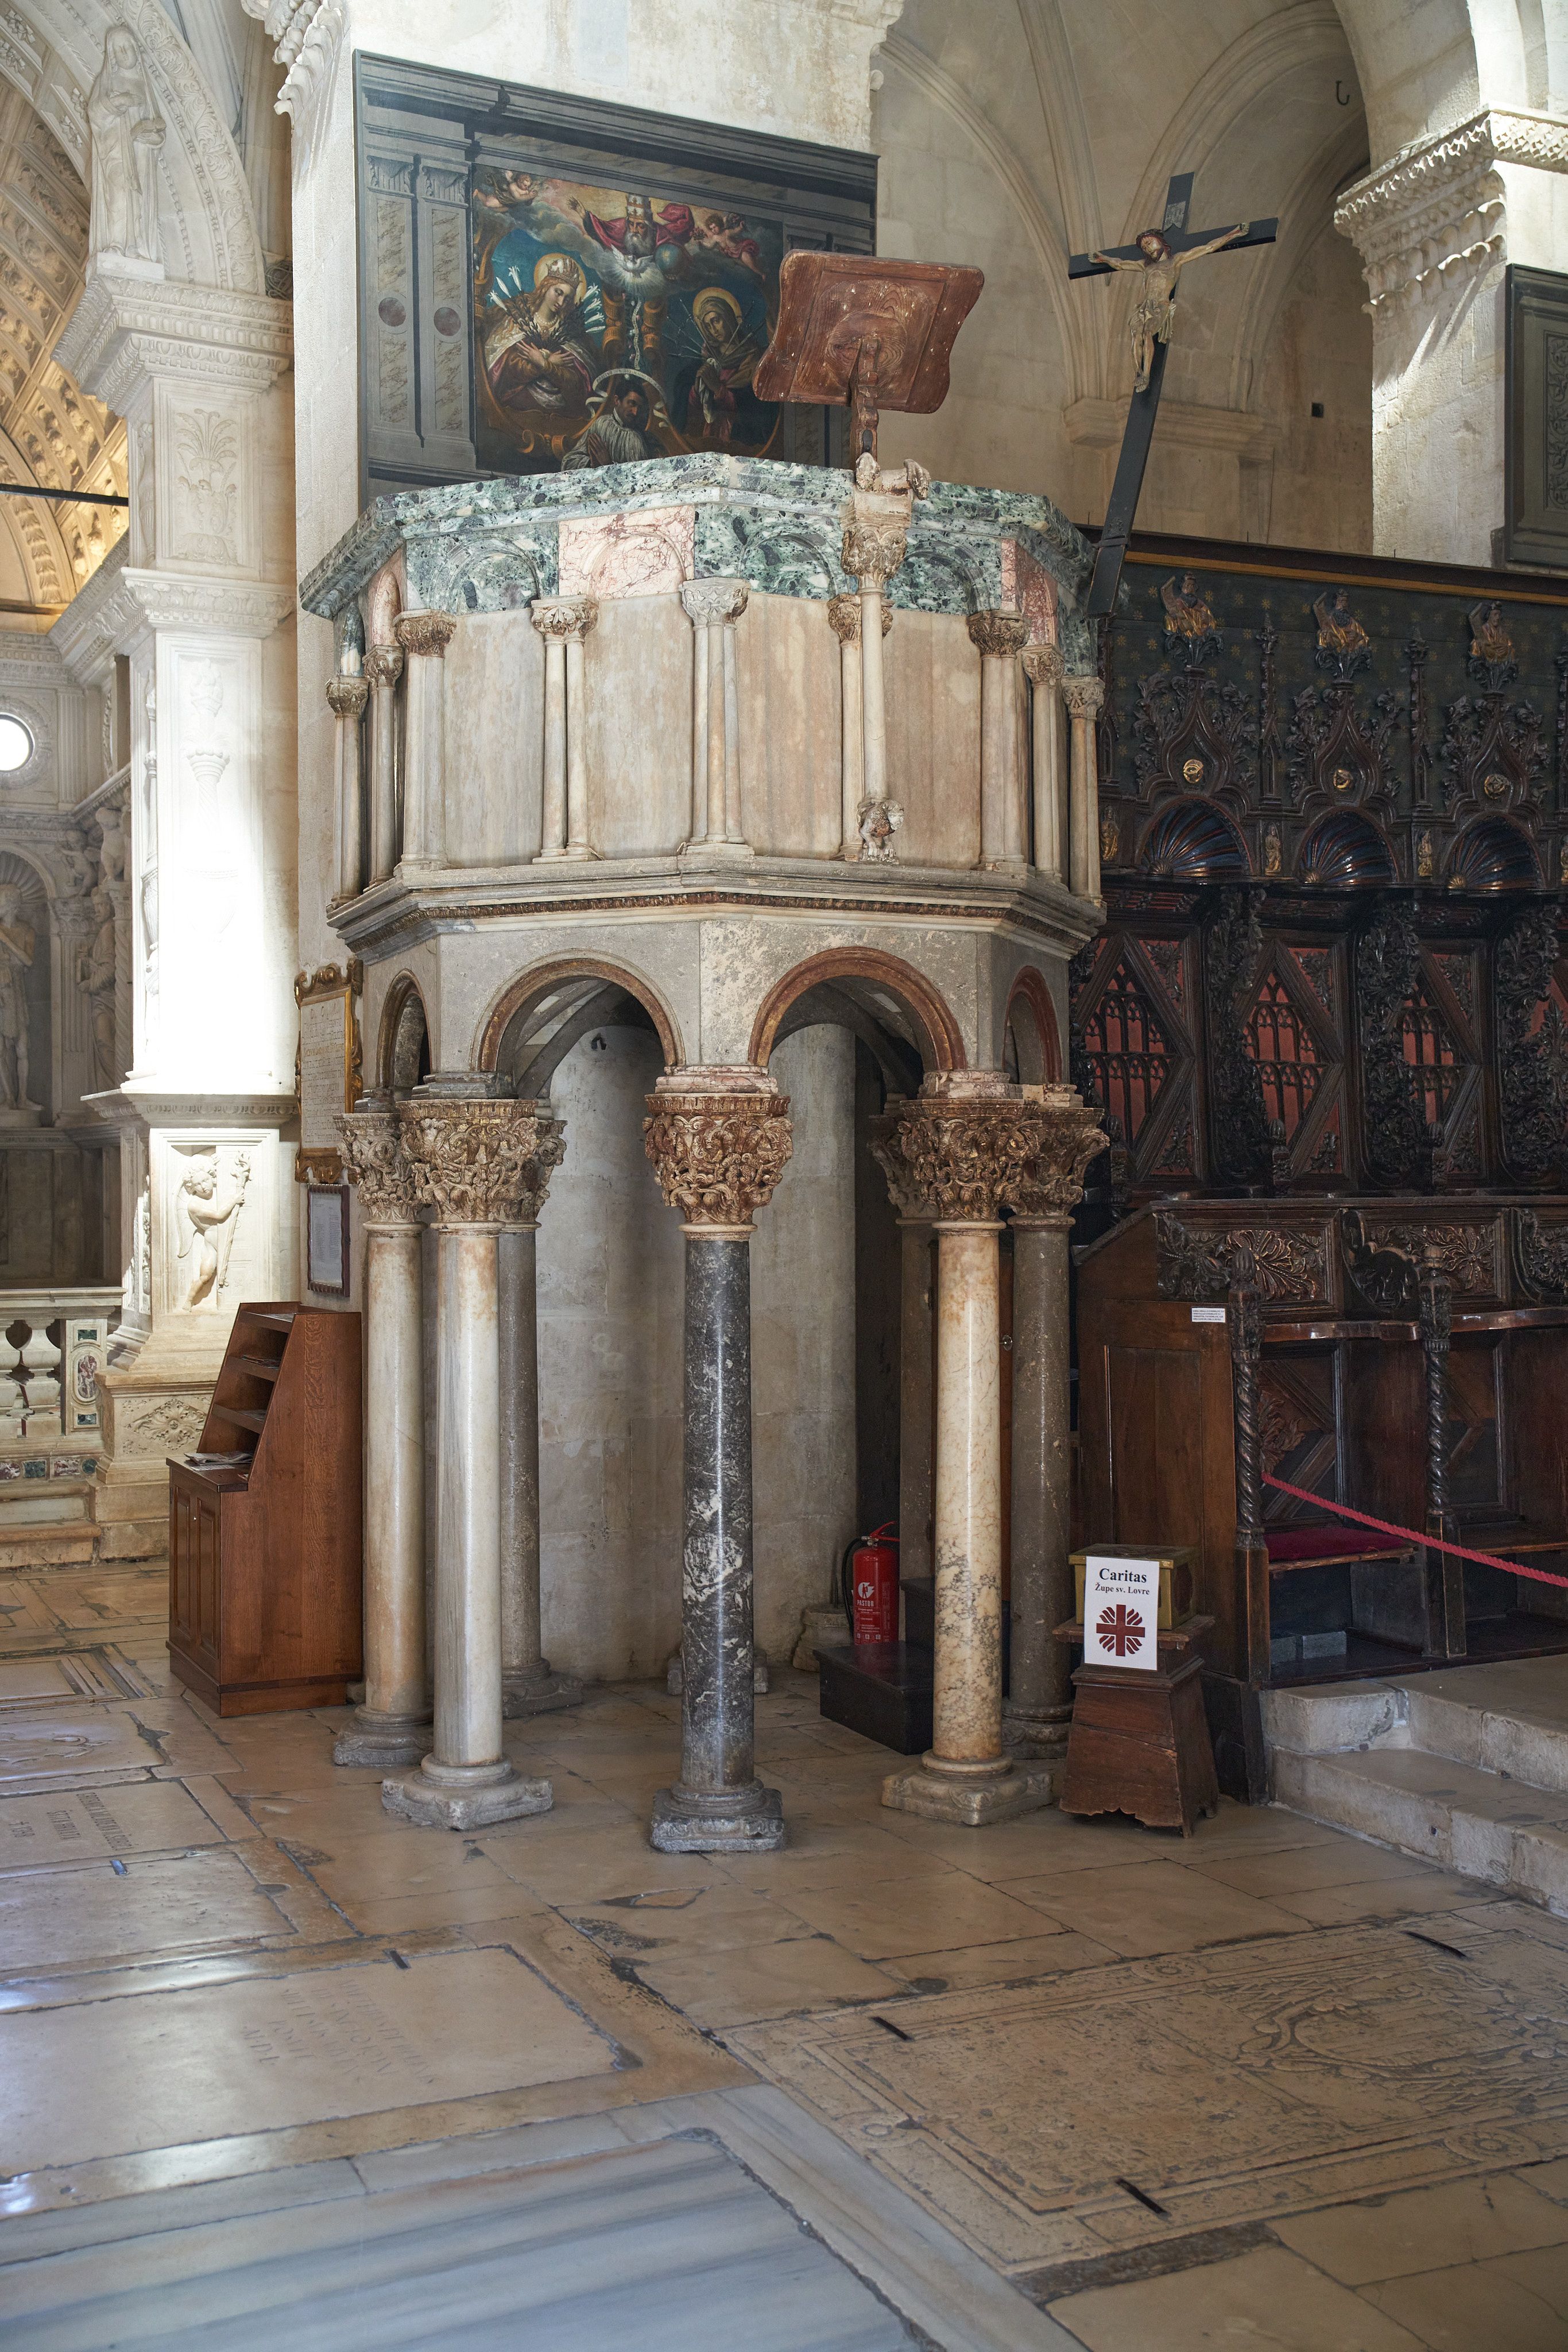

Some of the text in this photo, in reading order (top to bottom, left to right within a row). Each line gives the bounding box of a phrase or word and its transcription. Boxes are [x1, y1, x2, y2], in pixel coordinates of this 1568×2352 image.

[1099, 1568, 1147, 1583] Caritas
[1095, 1583, 1114, 1593] Župe
[1128, 1587, 1150, 1595] Lovre
